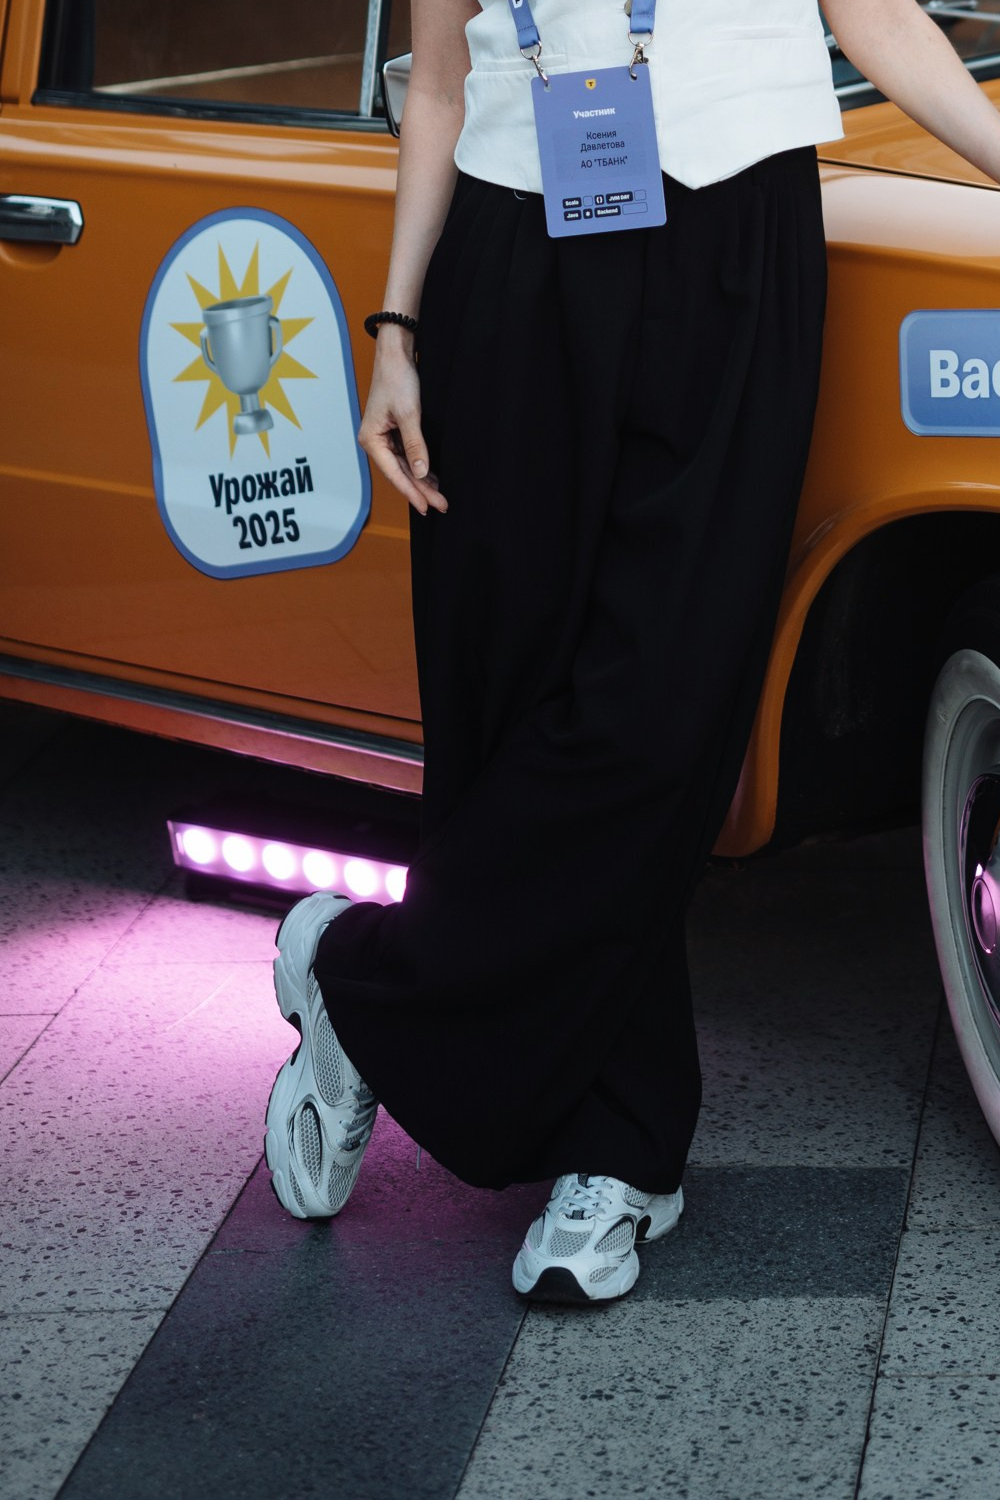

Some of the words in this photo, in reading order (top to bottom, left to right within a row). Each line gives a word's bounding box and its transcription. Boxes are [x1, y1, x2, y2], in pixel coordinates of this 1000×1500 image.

[573, 107, 616, 119] Участник
[586, 130, 617, 140] Ксения
[580, 141, 625, 153] Давлетова
[581, 160, 593, 169] АО
[208, 457, 314, 515] Урожай
[232, 508, 300, 550] 2025
